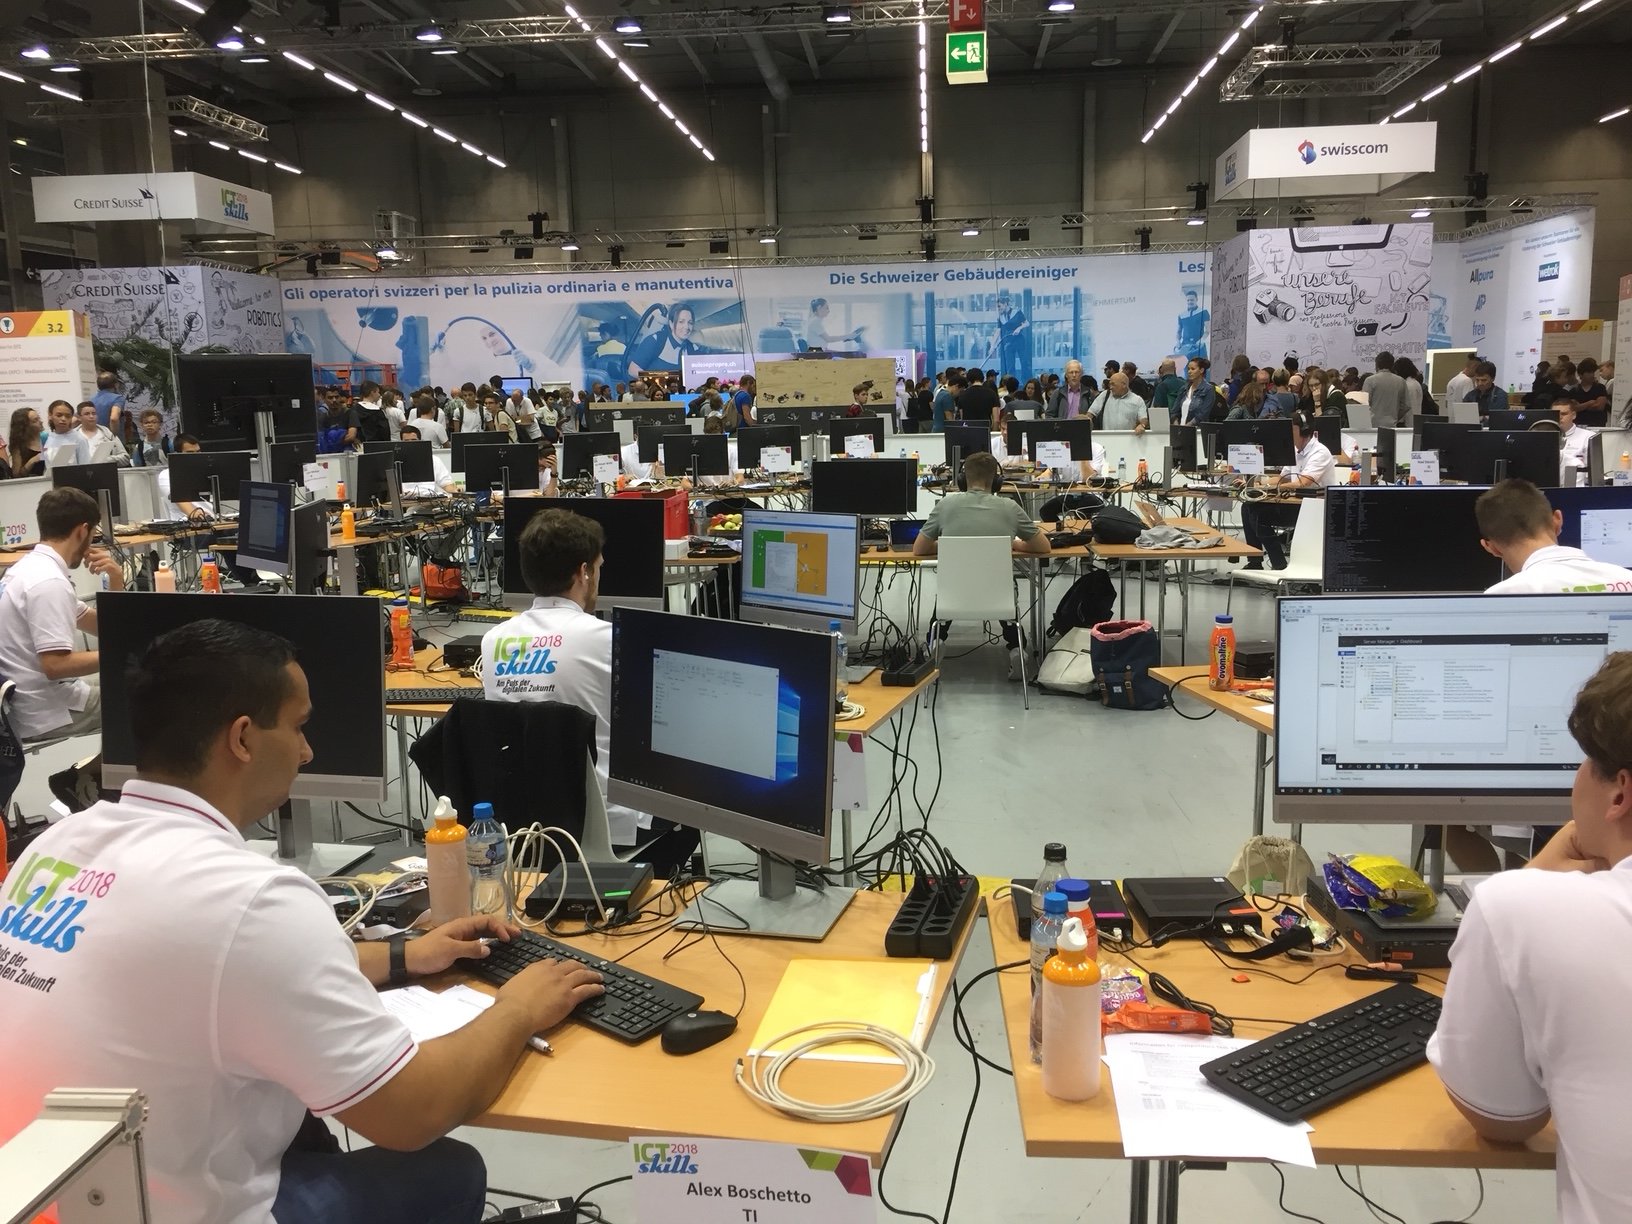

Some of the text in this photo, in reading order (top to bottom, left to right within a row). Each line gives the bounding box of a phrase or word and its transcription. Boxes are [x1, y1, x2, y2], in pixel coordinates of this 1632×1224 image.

[1320, 142, 1388, 156] swisscom
[74, 197, 144, 210] CREDIT SUISSE
[223, 201, 249, 222] skills
[829, 265, 1078, 286] Die Schweizer Gebäudereiniger
[1178, 261, 1206, 273] Les
[74, 282, 166, 298] CREDIT SUISSE
[284, 287, 305, 301] Gli
[309, 285, 379, 302] operatori
[384, 284, 439, 299] svizzeri
[444, 284, 470, 300] per
[474, 283, 488, 297] la
[492, 281, 543, 299] pulizia
[546, 279, 617, 294] ordinaria
[621, 281, 631, 292] e
[635, 276, 734, 292] manutentiva
[47, 323, 64, 334] 3.2
[246, 309, 282, 328] ROBOTICS
[6, 523, 27, 537] 2018
[493, 634, 563, 662] ICT 2018
[1217, 636, 1228, 679] ovomaltine
[494, 648, 558, 677] skills
[496, 678, 531, 688] Am Puls der
[502, 684, 556, 695] digitalen Zukunft
[7, 852, 116, 913] ICT 2018
[0, 885, 88, 953] skills
[10, 951, 28, 968] der
[14, 968, 57, 993] Zukunft
[633, 1143, 699, 1164] ICT 2018
[638, 1153, 699, 1175] skills
[686, 1181, 812, 1205] Alex Boschetto
[742, 1207, 758, 1223] TI
